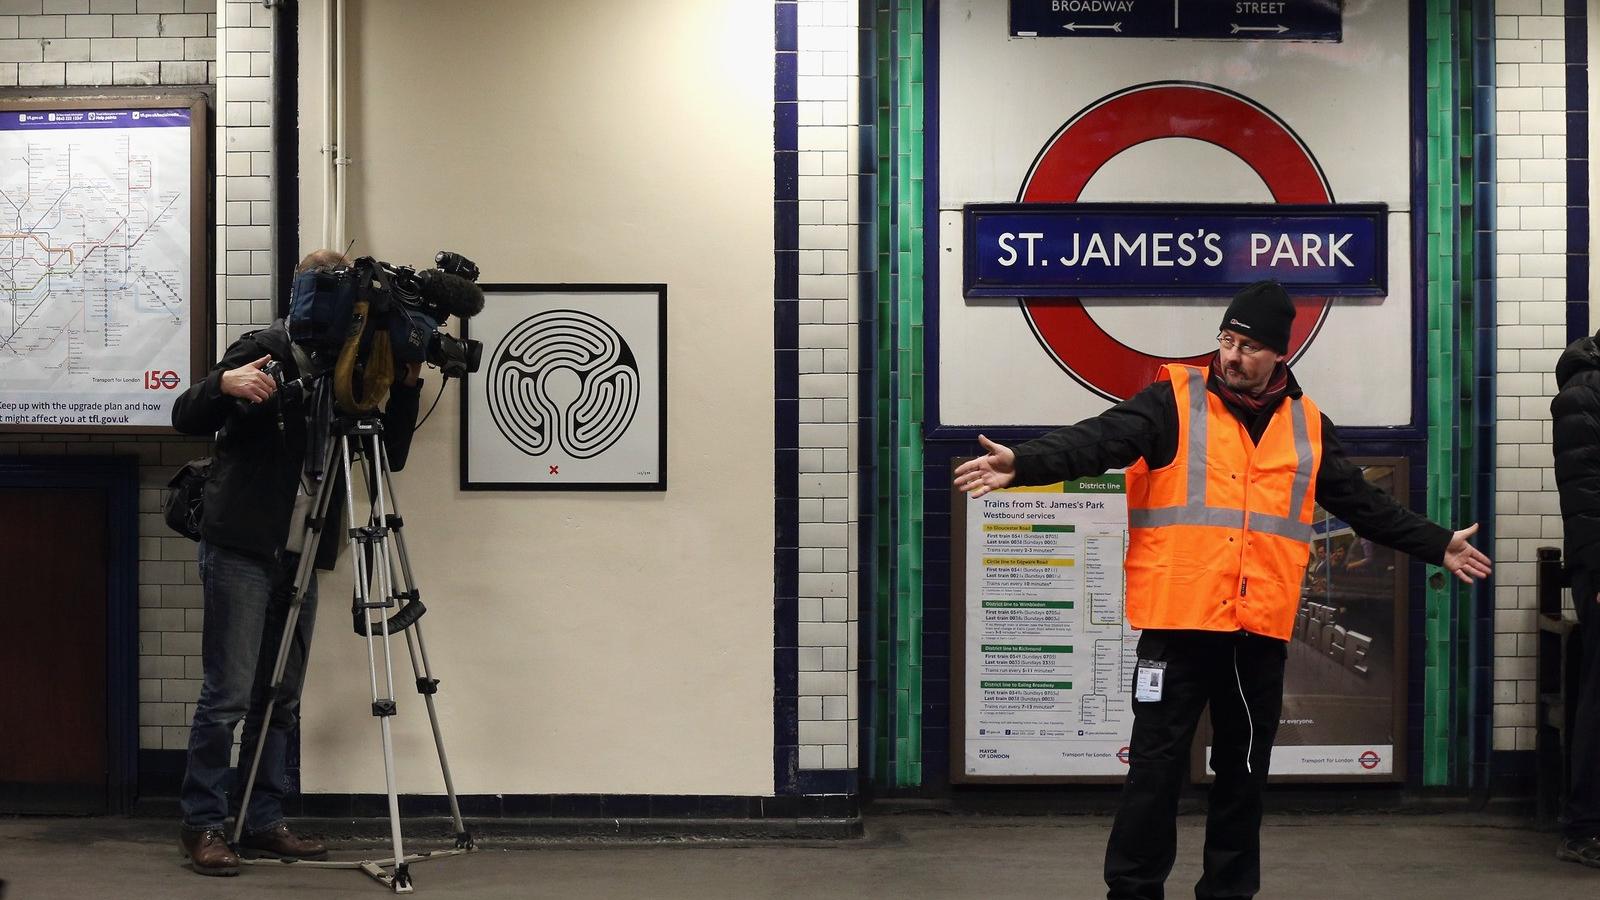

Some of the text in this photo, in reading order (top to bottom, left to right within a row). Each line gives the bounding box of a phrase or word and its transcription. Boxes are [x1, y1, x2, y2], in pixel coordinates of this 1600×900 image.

[1052, 0, 1134, 12] BROADWAY
[1235, 2, 1285, 14] STREET
[998, 228, 1354, 267] ST. JAMES'S PARK
[0, 403, 161, 412] eep up with the upgrade plan and how
[5, 415, 30, 424] might
[31, 415, 57, 424] affect
[59, 415, 75, 424] you
[77, 415, 87, 424] at
[89, 415, 129, 424] tfl.gov.uk
[1079, 482, 1121, 490] District line
[984, 500, 1105, 510] Trains from St. James's Park
